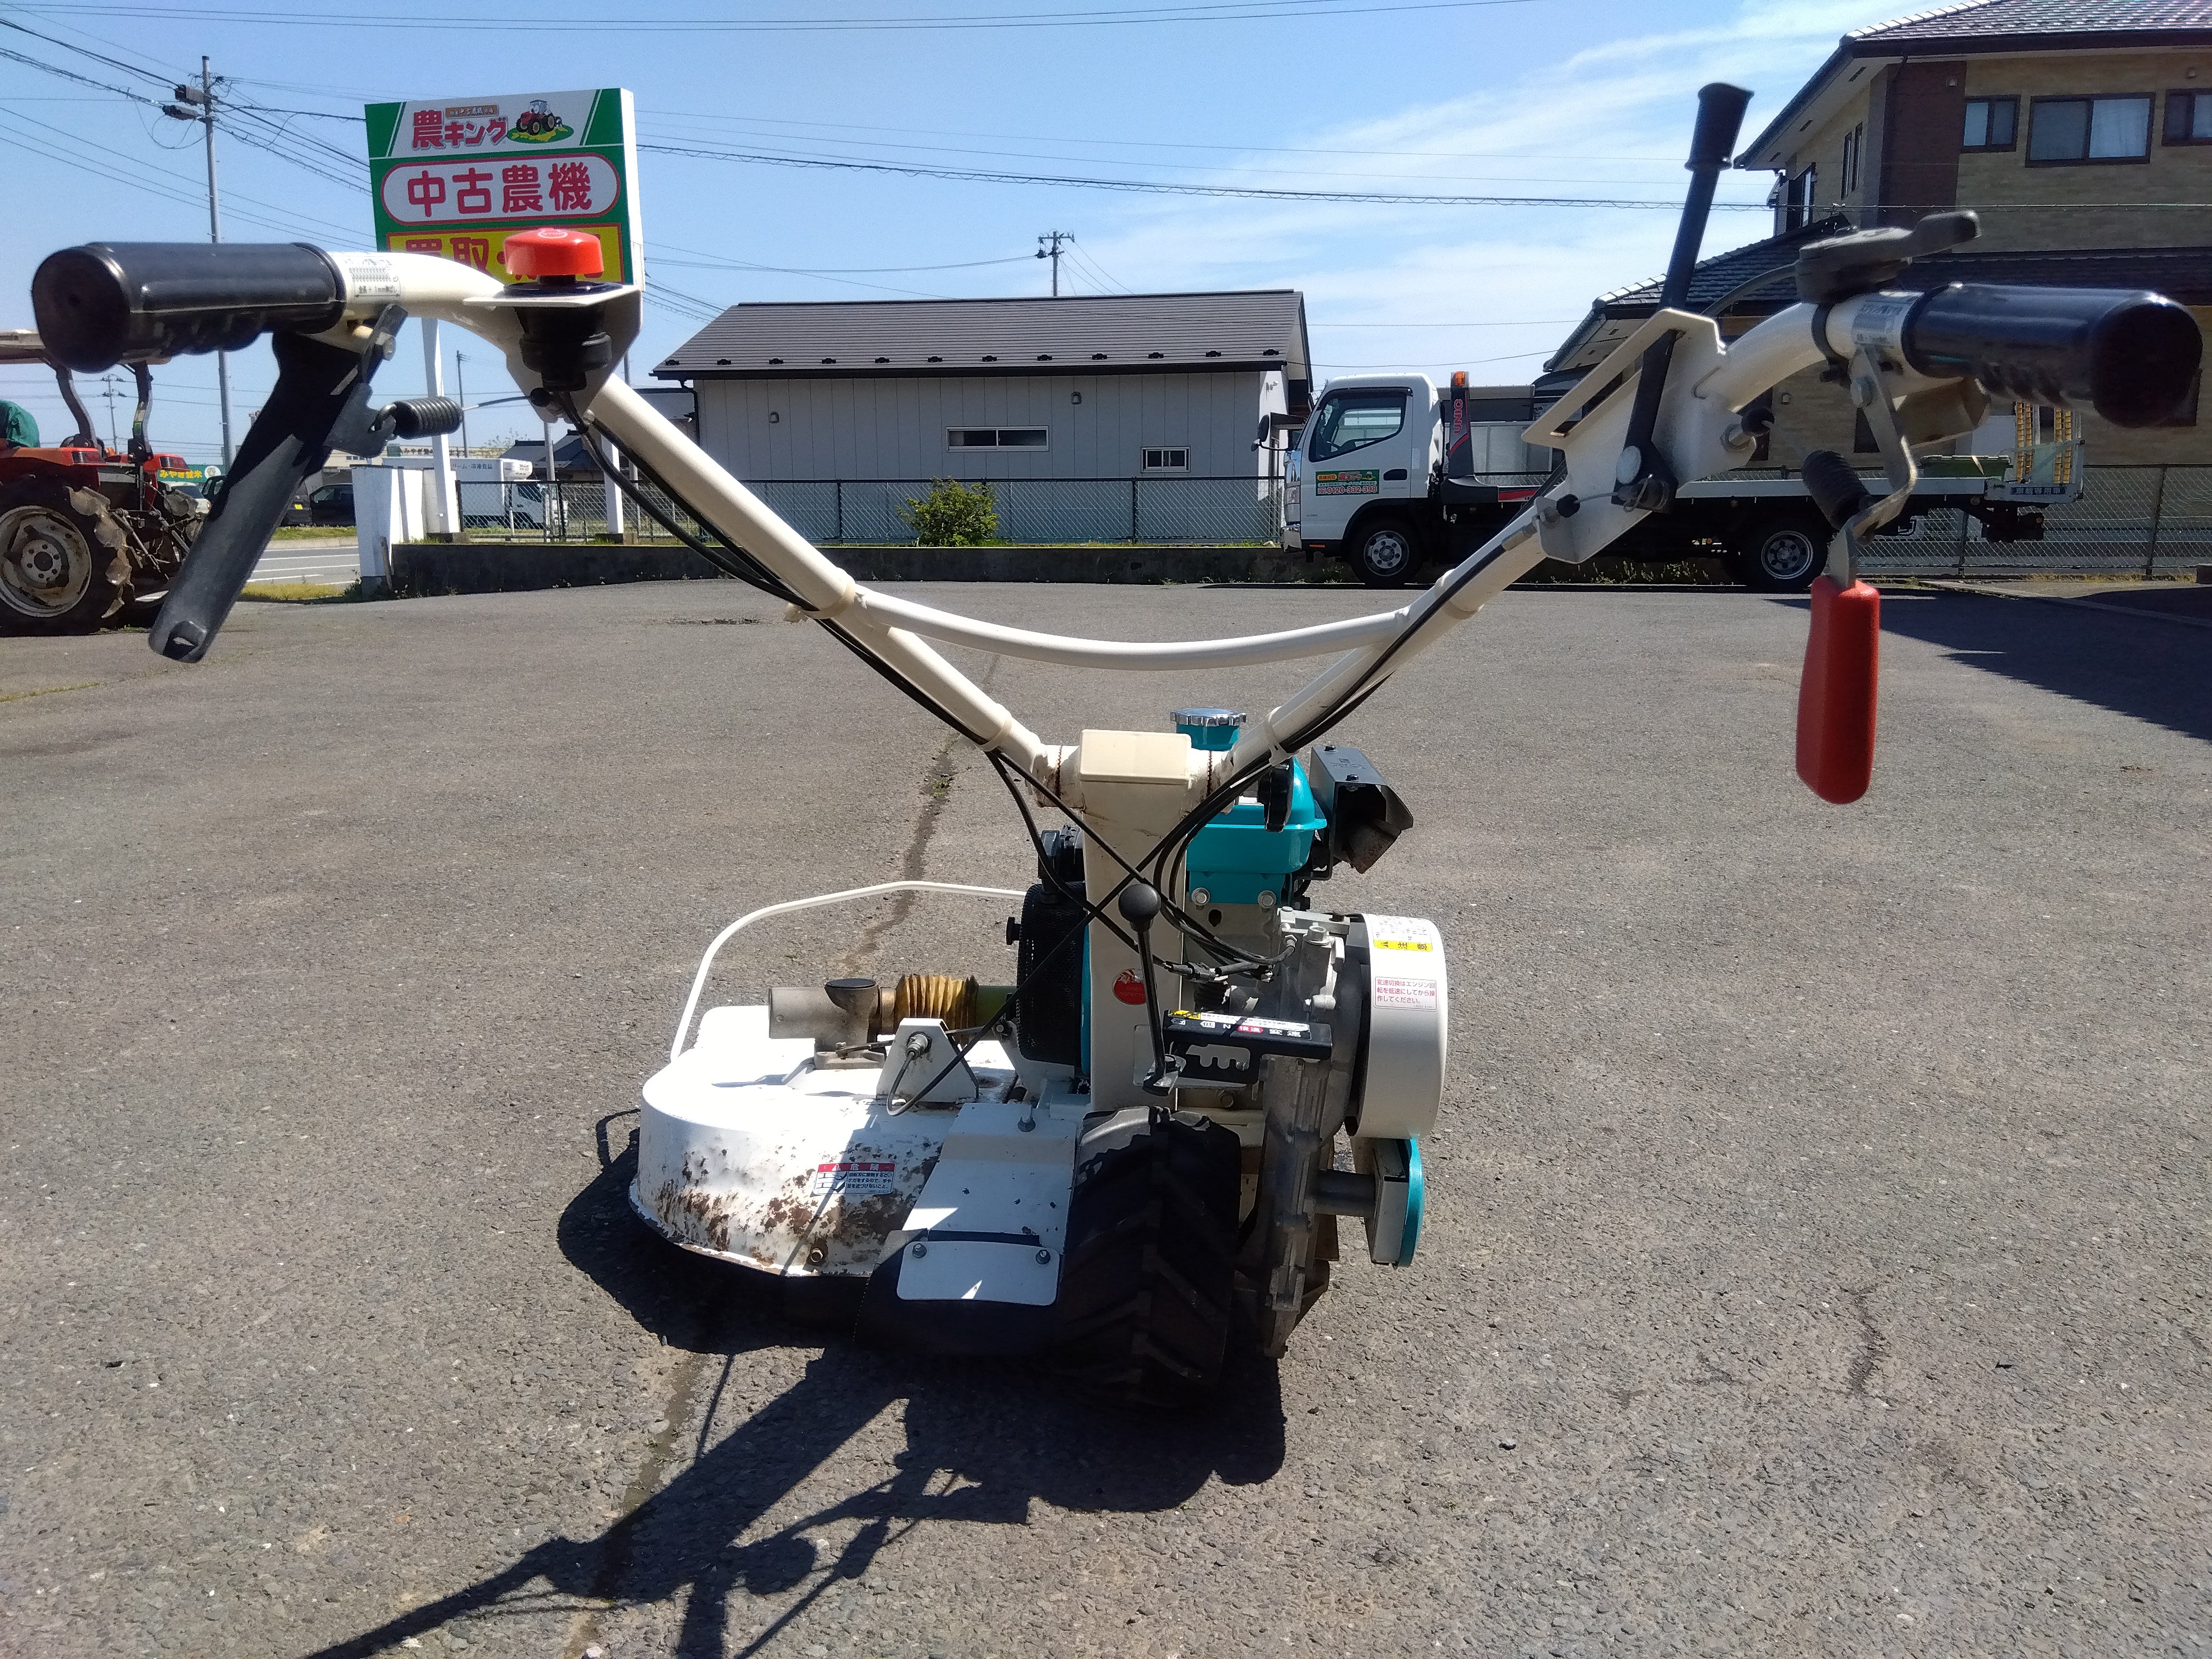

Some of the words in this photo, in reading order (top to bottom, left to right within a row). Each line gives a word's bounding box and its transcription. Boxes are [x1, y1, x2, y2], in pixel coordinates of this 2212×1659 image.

[413, 110, 506, 148] 農キング
[407, 161, 592, 217] 中古農機
[1453, 399, 1463, 434] UNIC
[160, 470, 203, 479] みやぎ登米
[1327, 485, 1378, 495] 0120-332-398
[1377, 979, 1435, 988] 変速切換はエンジン回
[1377, 987, 1436, 996] 転を低速にしてから操
[1377, 995, 1421, 1004] 作してください。
